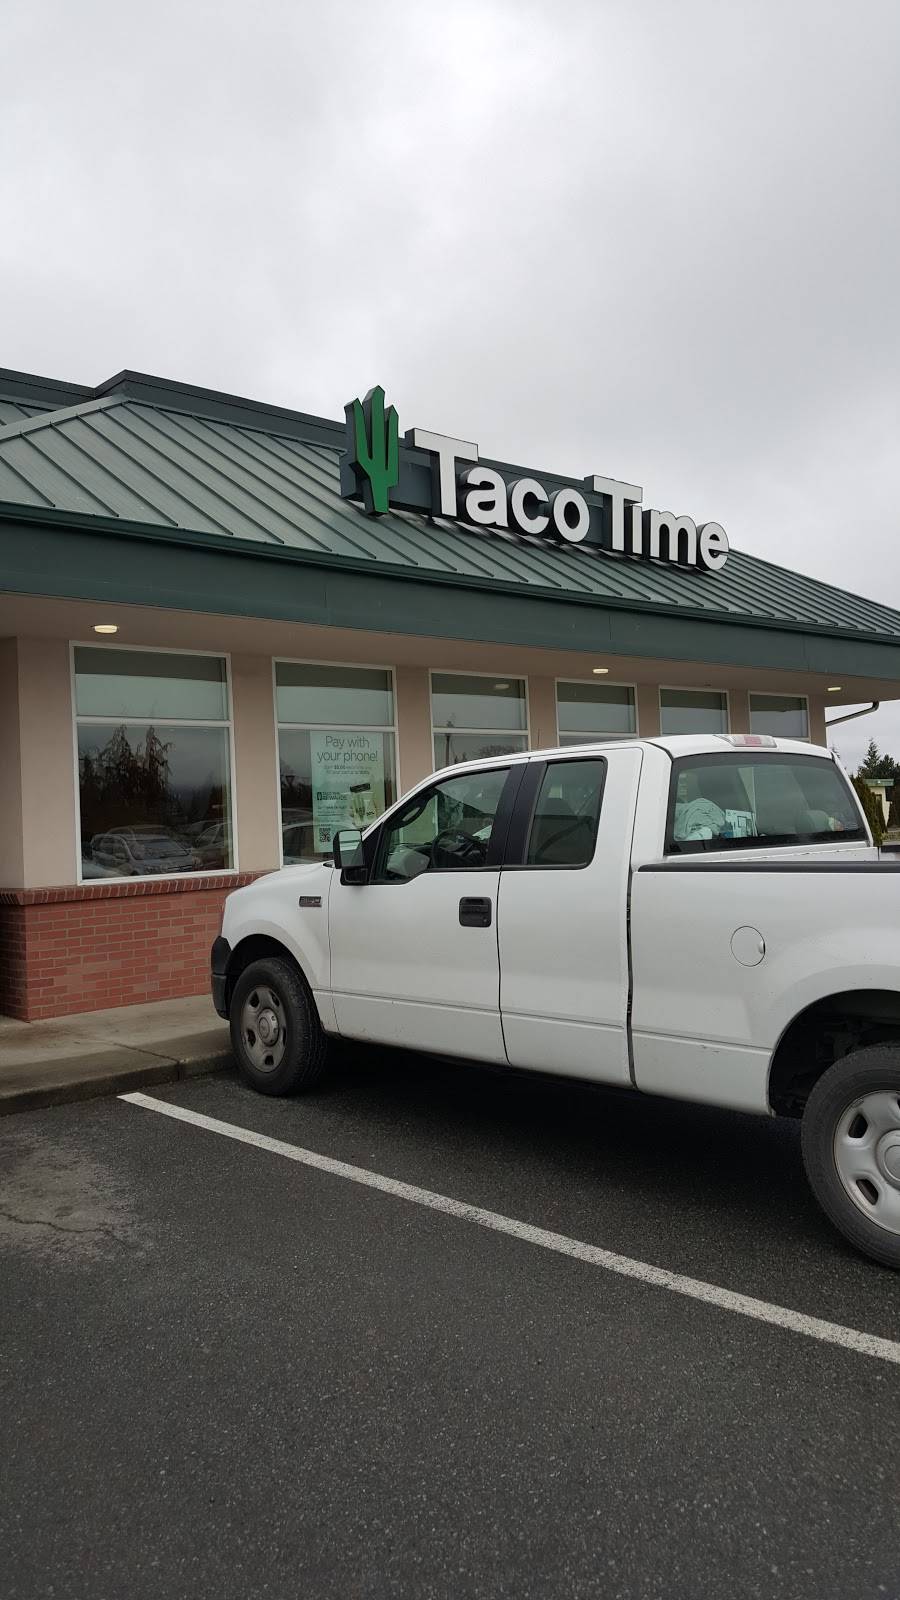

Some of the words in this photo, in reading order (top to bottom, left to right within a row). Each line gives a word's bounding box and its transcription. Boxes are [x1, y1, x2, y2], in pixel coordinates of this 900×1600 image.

[409, 427, 591, 543] Taco
[588, 474, 730, 572] Time
[325, 735, 345, 749] Pay
[348, 735, 370, 748] with
[317, 751, 342, 764] your
[343, 750, 378, 763] phone!
